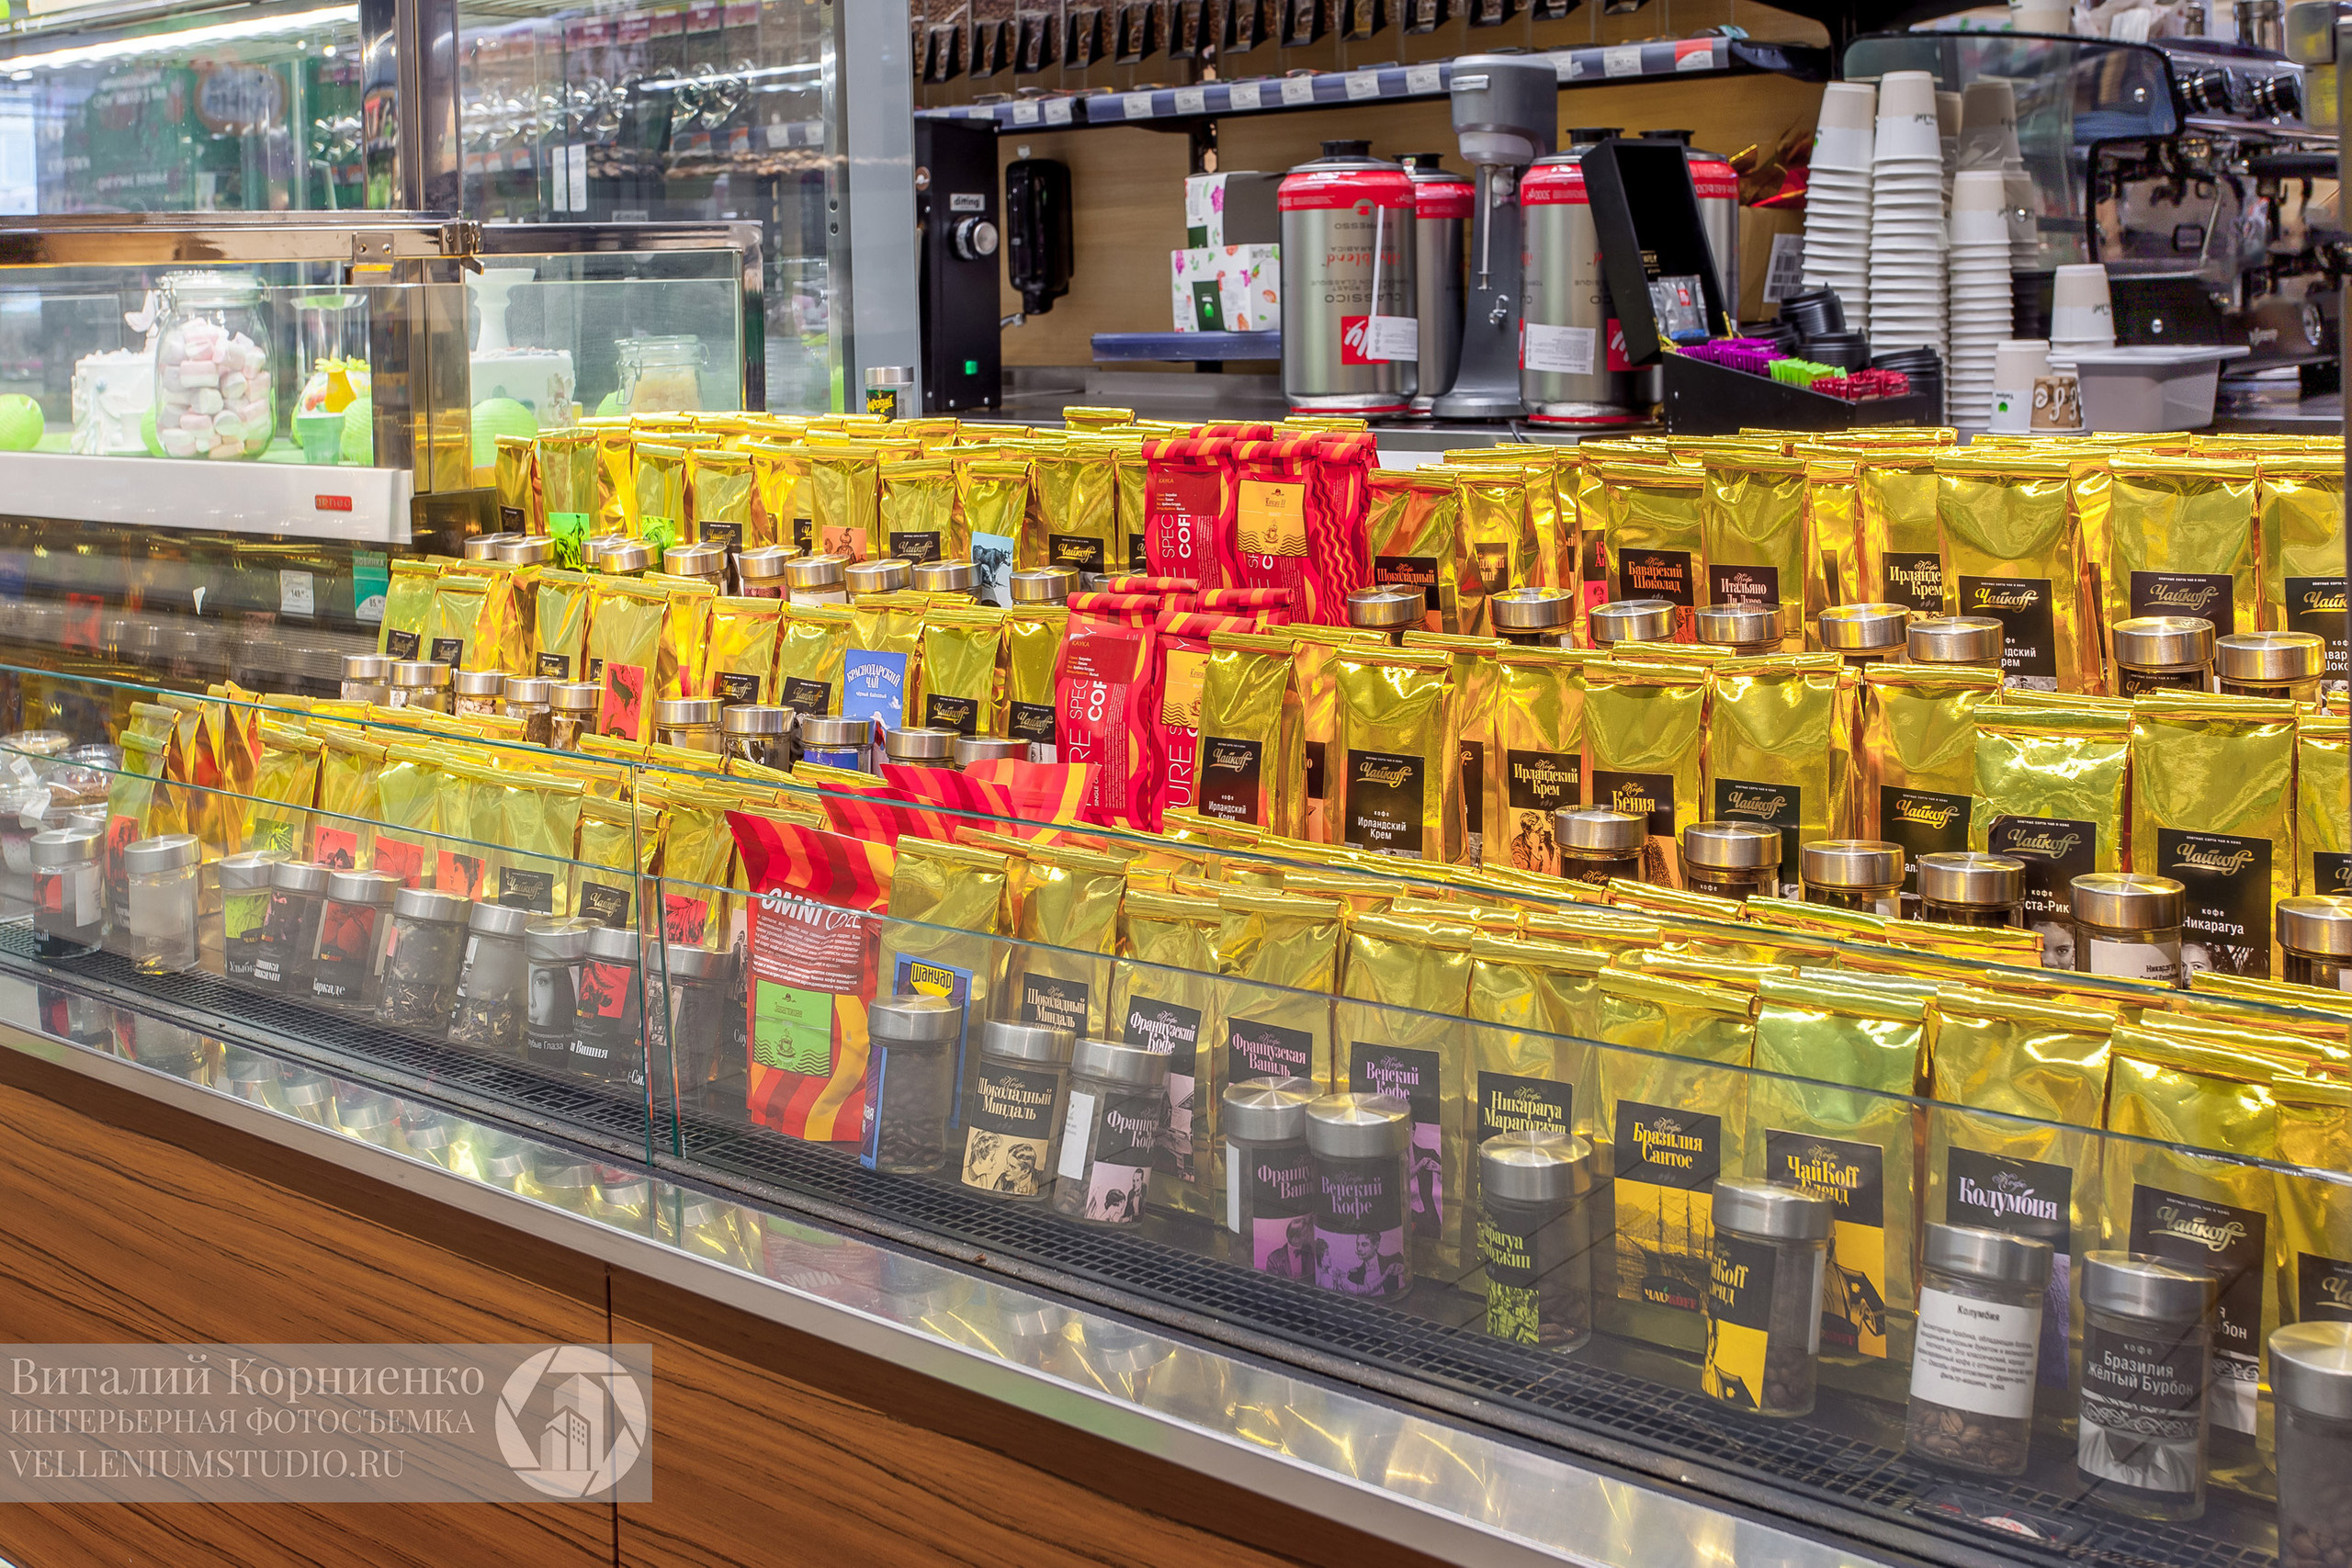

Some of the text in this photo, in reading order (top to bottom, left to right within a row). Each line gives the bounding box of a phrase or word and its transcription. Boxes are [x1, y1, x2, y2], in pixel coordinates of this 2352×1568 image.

[1628, 561, 1683, 579] Баварский
[1889, 565, 1941, 585] Ирландс
[1634, 574, 1681, 592] Шоколад
[1721, 578, 1768, 595] Итальяно
[2001, 657, 2020, 668] рем
[846, 663, 901, 687] КРАСНОДАРСКИЙ
[865, 675, 879, 689] ЧАЙ
[1513, 763, 1578, 784] Ирландский
[1532, 780, 1561, 798] Крем
[1208, 801, 1247, 815] Ирландский
[1611, 790, 1656, 812] Кения
[1358, 817, 1407, 831] Ирландский
[1370, 829, 1392, 840] Крем
[2031, 889, 2052, 897] кофе
[762, 887, 823, 926] OMNI
[2025, 900, 2070, 914] ста-Рик
[2201, 908, 2224, 917] кофе
[1027, 987, 1085, 1015] Шоколадный
[1035, 1005, 1076, 1028] Миндаль
[1130, 1011, 1195, 1042] Французский
[543, 1040, 564, 1051] Глаза
[576, 1041, 608, 1059] Вишня
[1232, 1033, 1306, 1065] Французская
[1250, 1054, 1291, 1077] Ваниль
[1366, 1061, 1419, 1085] Венский
[978, 1077, 1052, 1105] Шоколадный
[1376, 1079, 1410, 1101] Кофе
[982, 1096, 1036, 1121] Миндаль
[1491, 1090, 1562, 1122] Никарагуа
[1633, 1122, 1703, 1152] Бразилия
[1642, 1143, 1693, 1169] Сантос
[1321, 1176, 1382, 1197] Венский
[1332, 1197, 1372, 1220] Кофе
[1958, 1176, 2058, 1221] Колумбия
[2124, 1344, 2153, 1356] кофе
[2103, 1350, 2174, 1378] Бразилия
[2087, 1360, 2194, 1397] Жёлтый Бурбон
